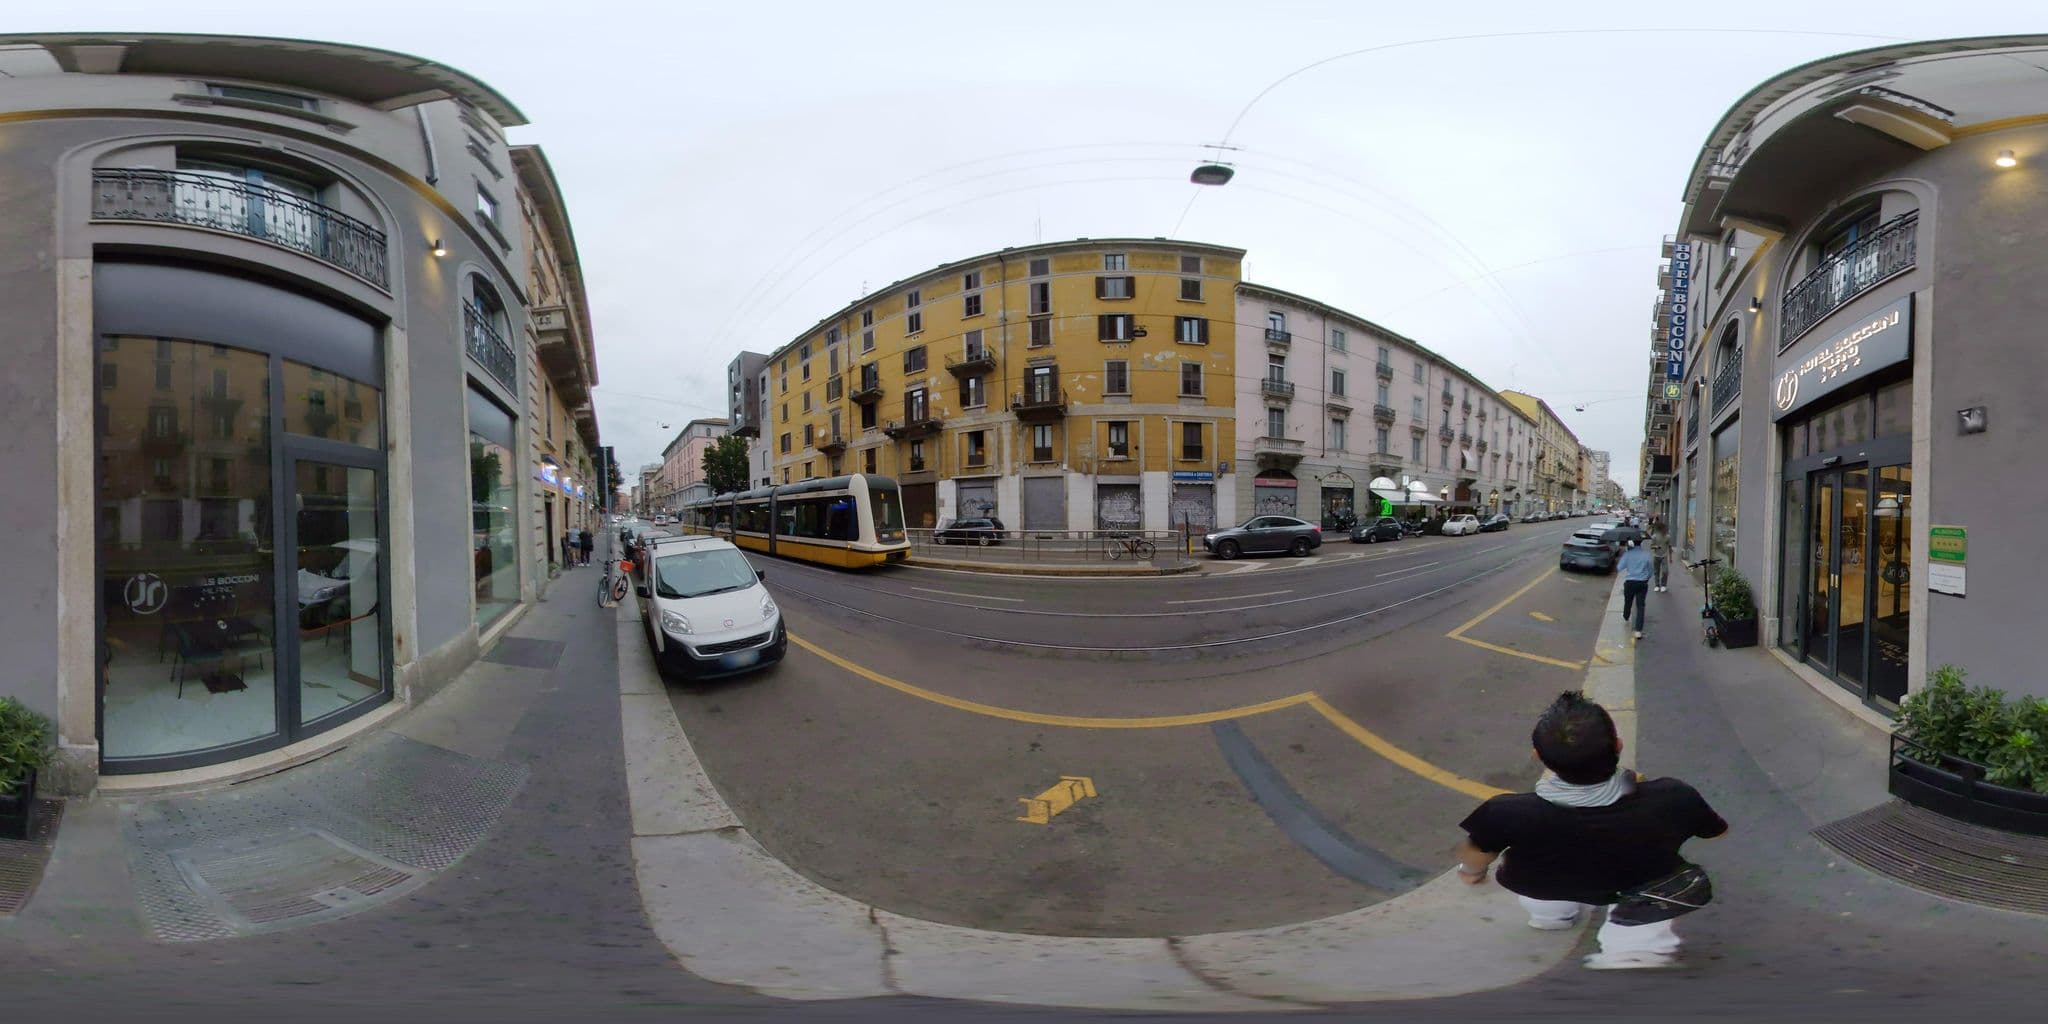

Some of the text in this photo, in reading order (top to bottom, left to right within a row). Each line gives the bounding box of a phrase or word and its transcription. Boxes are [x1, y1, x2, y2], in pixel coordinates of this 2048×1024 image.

[1676, 243, 1690, 288] HOTEL
[1670, 293, 1687, 376] BOCCONI
[1834, 310, 1900, 354] BOCCONI
[217, 574, 260, 585] BOCCONI
